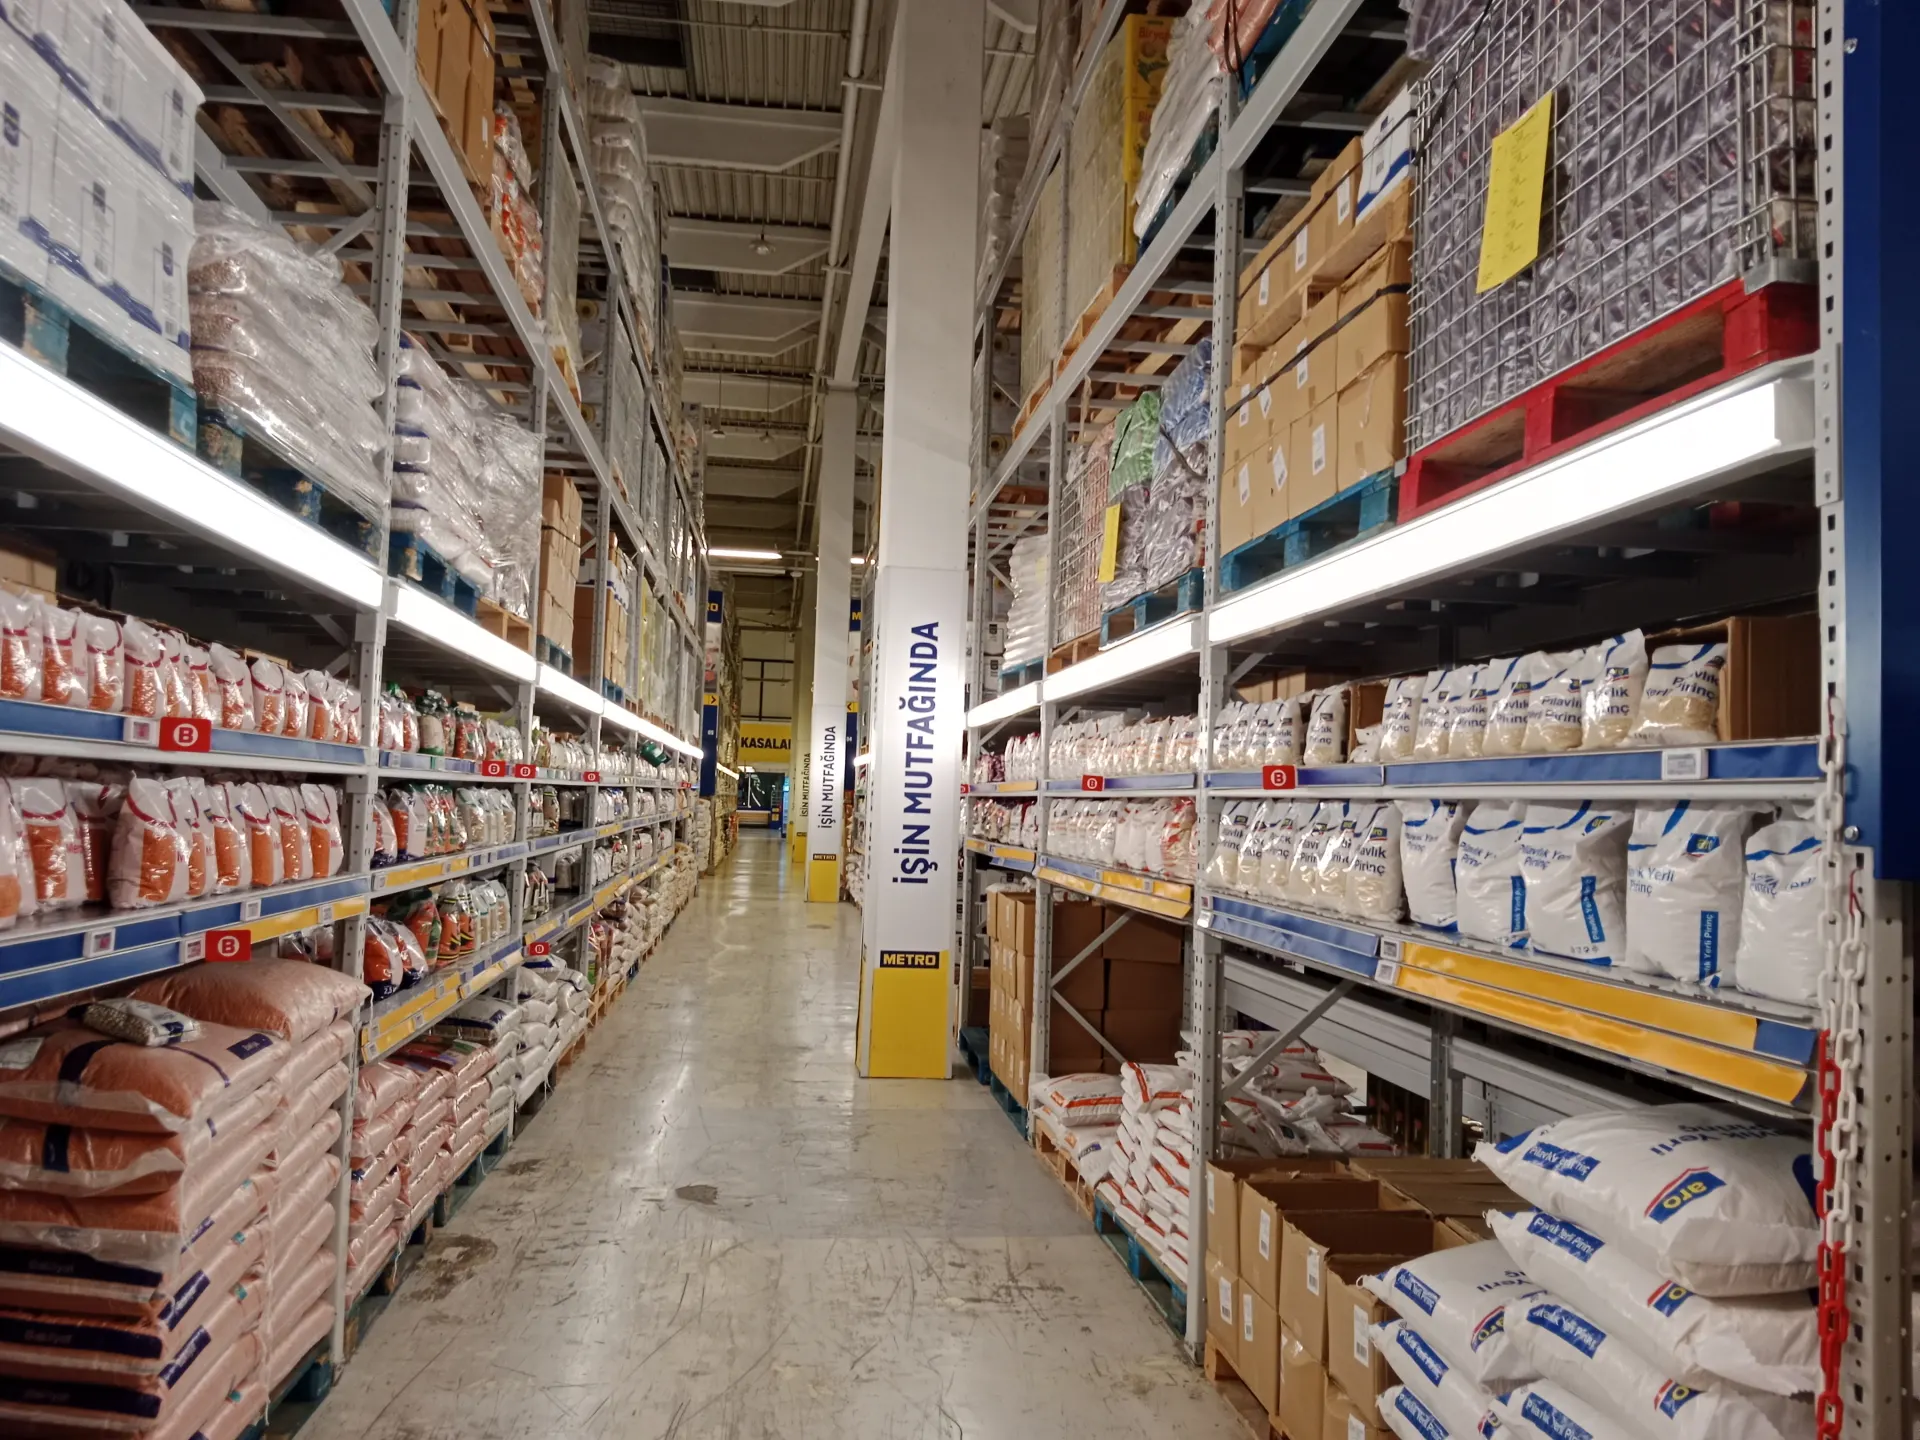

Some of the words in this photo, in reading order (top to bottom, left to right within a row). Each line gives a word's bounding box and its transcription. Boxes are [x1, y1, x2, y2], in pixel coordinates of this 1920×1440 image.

[899, 621, 939, 814] MUTFAĞINDA
[741, 737, 791, 750] KASALA
[820, 726, 836, 799] MUTFAĞINDA
[818, 805, 836, 828] İŞİN
[892, 824, 938, 884] İŞİN
[1354, 859, 1386, 876] Pirinç
[1648, 867, 1675, 883] Yerli
[1630, 879, 1653, 897] Pirinç
[1704, 913, 1715, 938] Pirinç
[883, 953, 937, 966] METRO
[1650, 1133, 1721, 1156] Yerli
[1662, 1181, 1708, 1209] aro
[1477, 1279, 1531, 1292] Yerli
